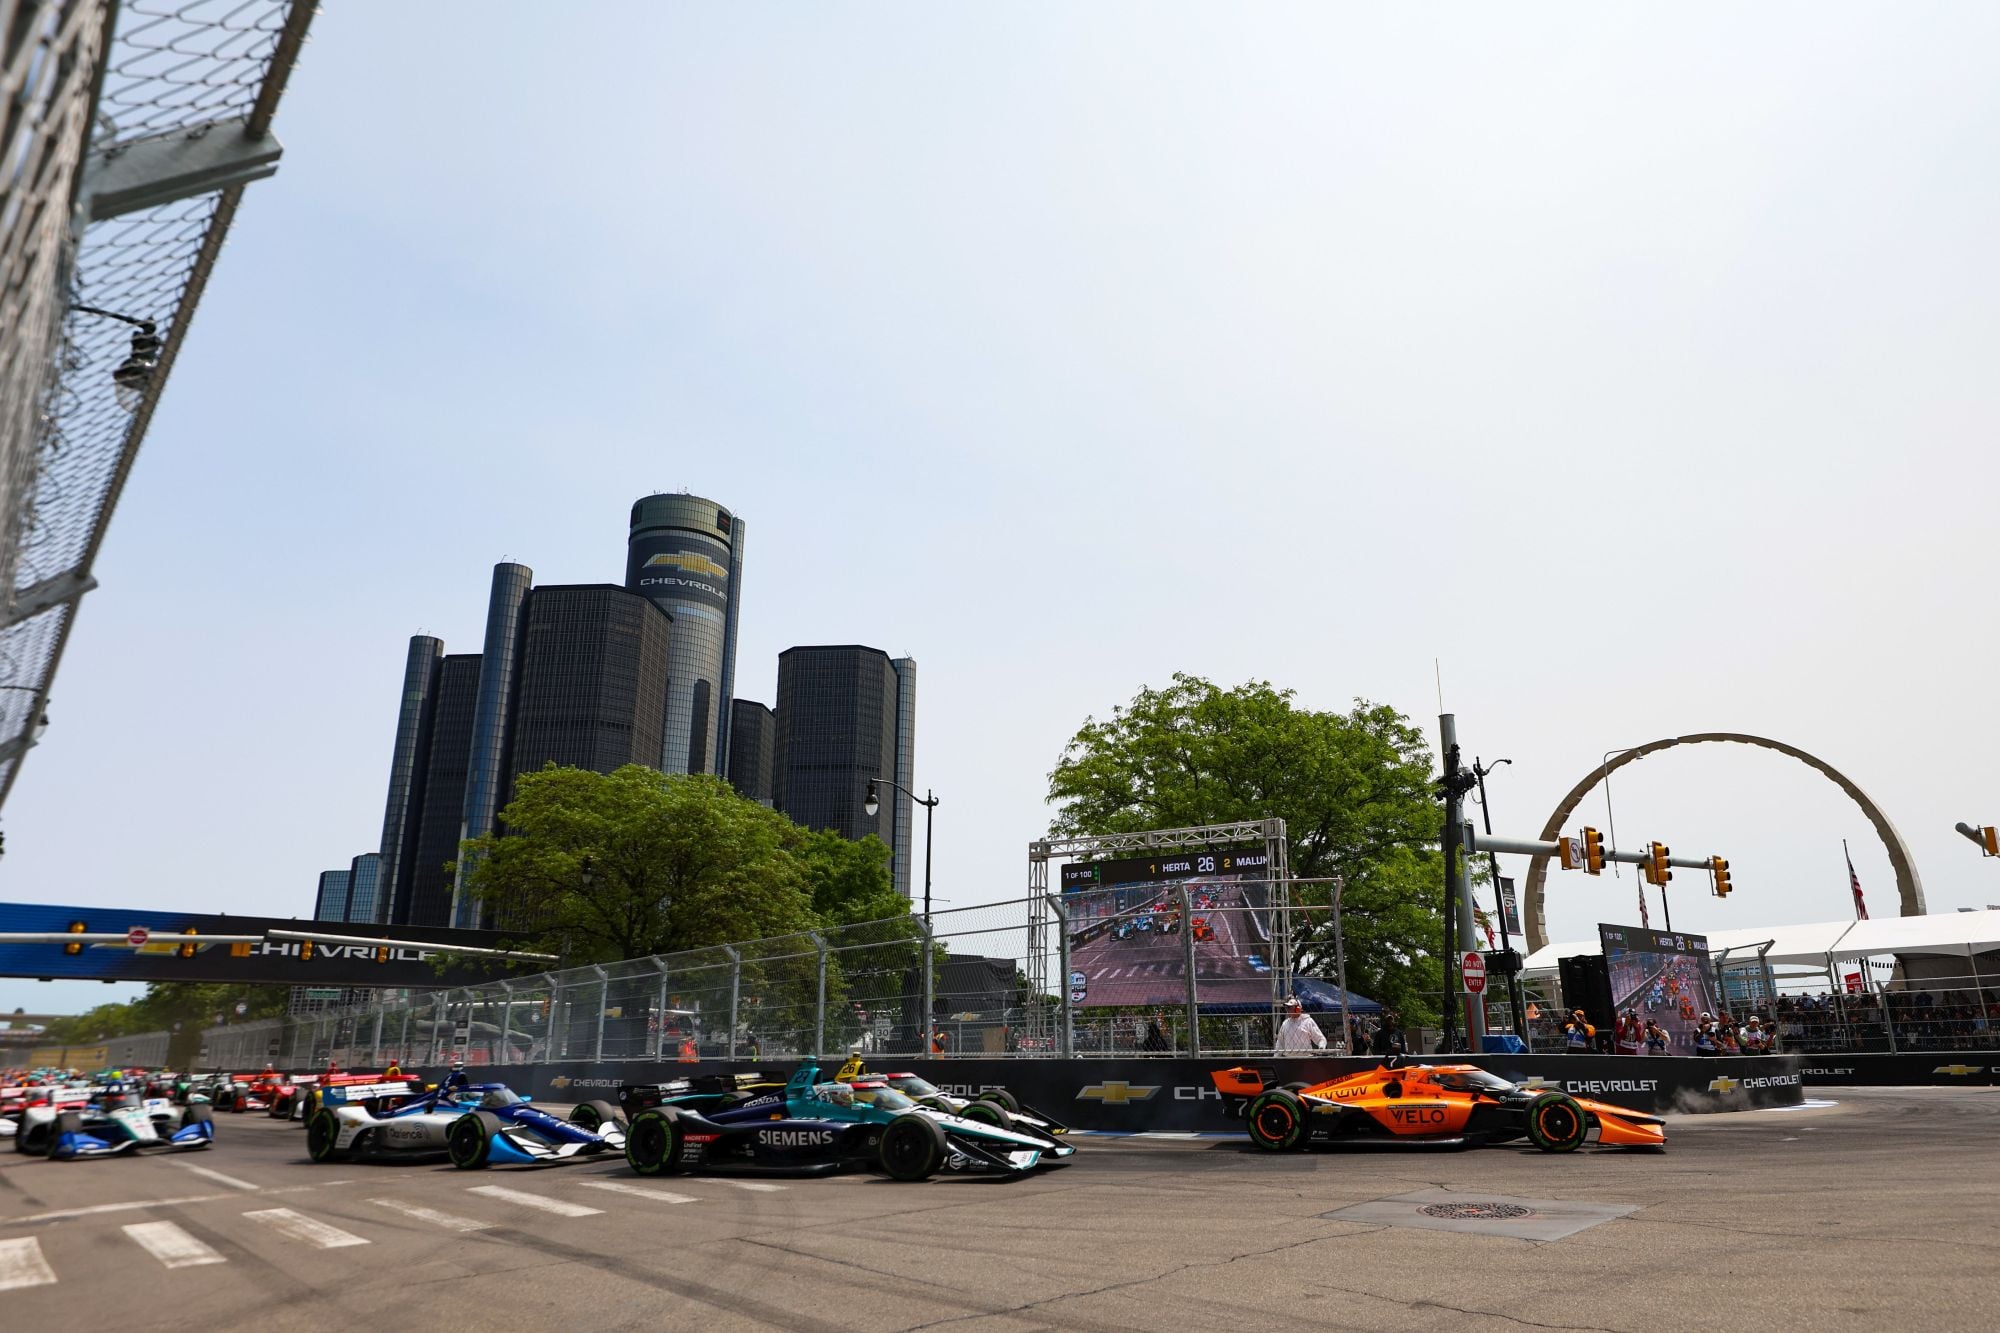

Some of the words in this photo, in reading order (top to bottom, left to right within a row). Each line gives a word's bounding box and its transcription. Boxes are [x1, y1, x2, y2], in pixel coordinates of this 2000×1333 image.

[1149, 864, 1156, 873] 1
[1162, 862, 1191, 872] HERTA
[1197, 856, 1215, 872] 26
[1223, 858, 1231, 868] 2
[1080, 870, 1092, 878] 100
[1652, 936, 1657, 946] 1
[1660, 937, 1674, 947] HERTA
[1675, 935, 1685, 950] 26
[1687, 940, 1692, 949] 2
[1473, 960, 1482, 968] NOT
[1468, 979, 1482, 987] ENTER
[1388, 1055, 1398, 1067] 7
[842, 1063, 856, 1074] 26
[573, 1080, 624, 1088] CHEVROLET
[1566, 1080, 1658, 1093] CHEVROLET
[1743, 1074, 1800, 1089] CHEVROLET
[743, 1095, 780, 1108] HONDA
[1234, 1098, 1248, 1117] 7
[1390, 1109, 1445, 1123] VELO
[758, 1130, 834, 1146] SIEMENS
